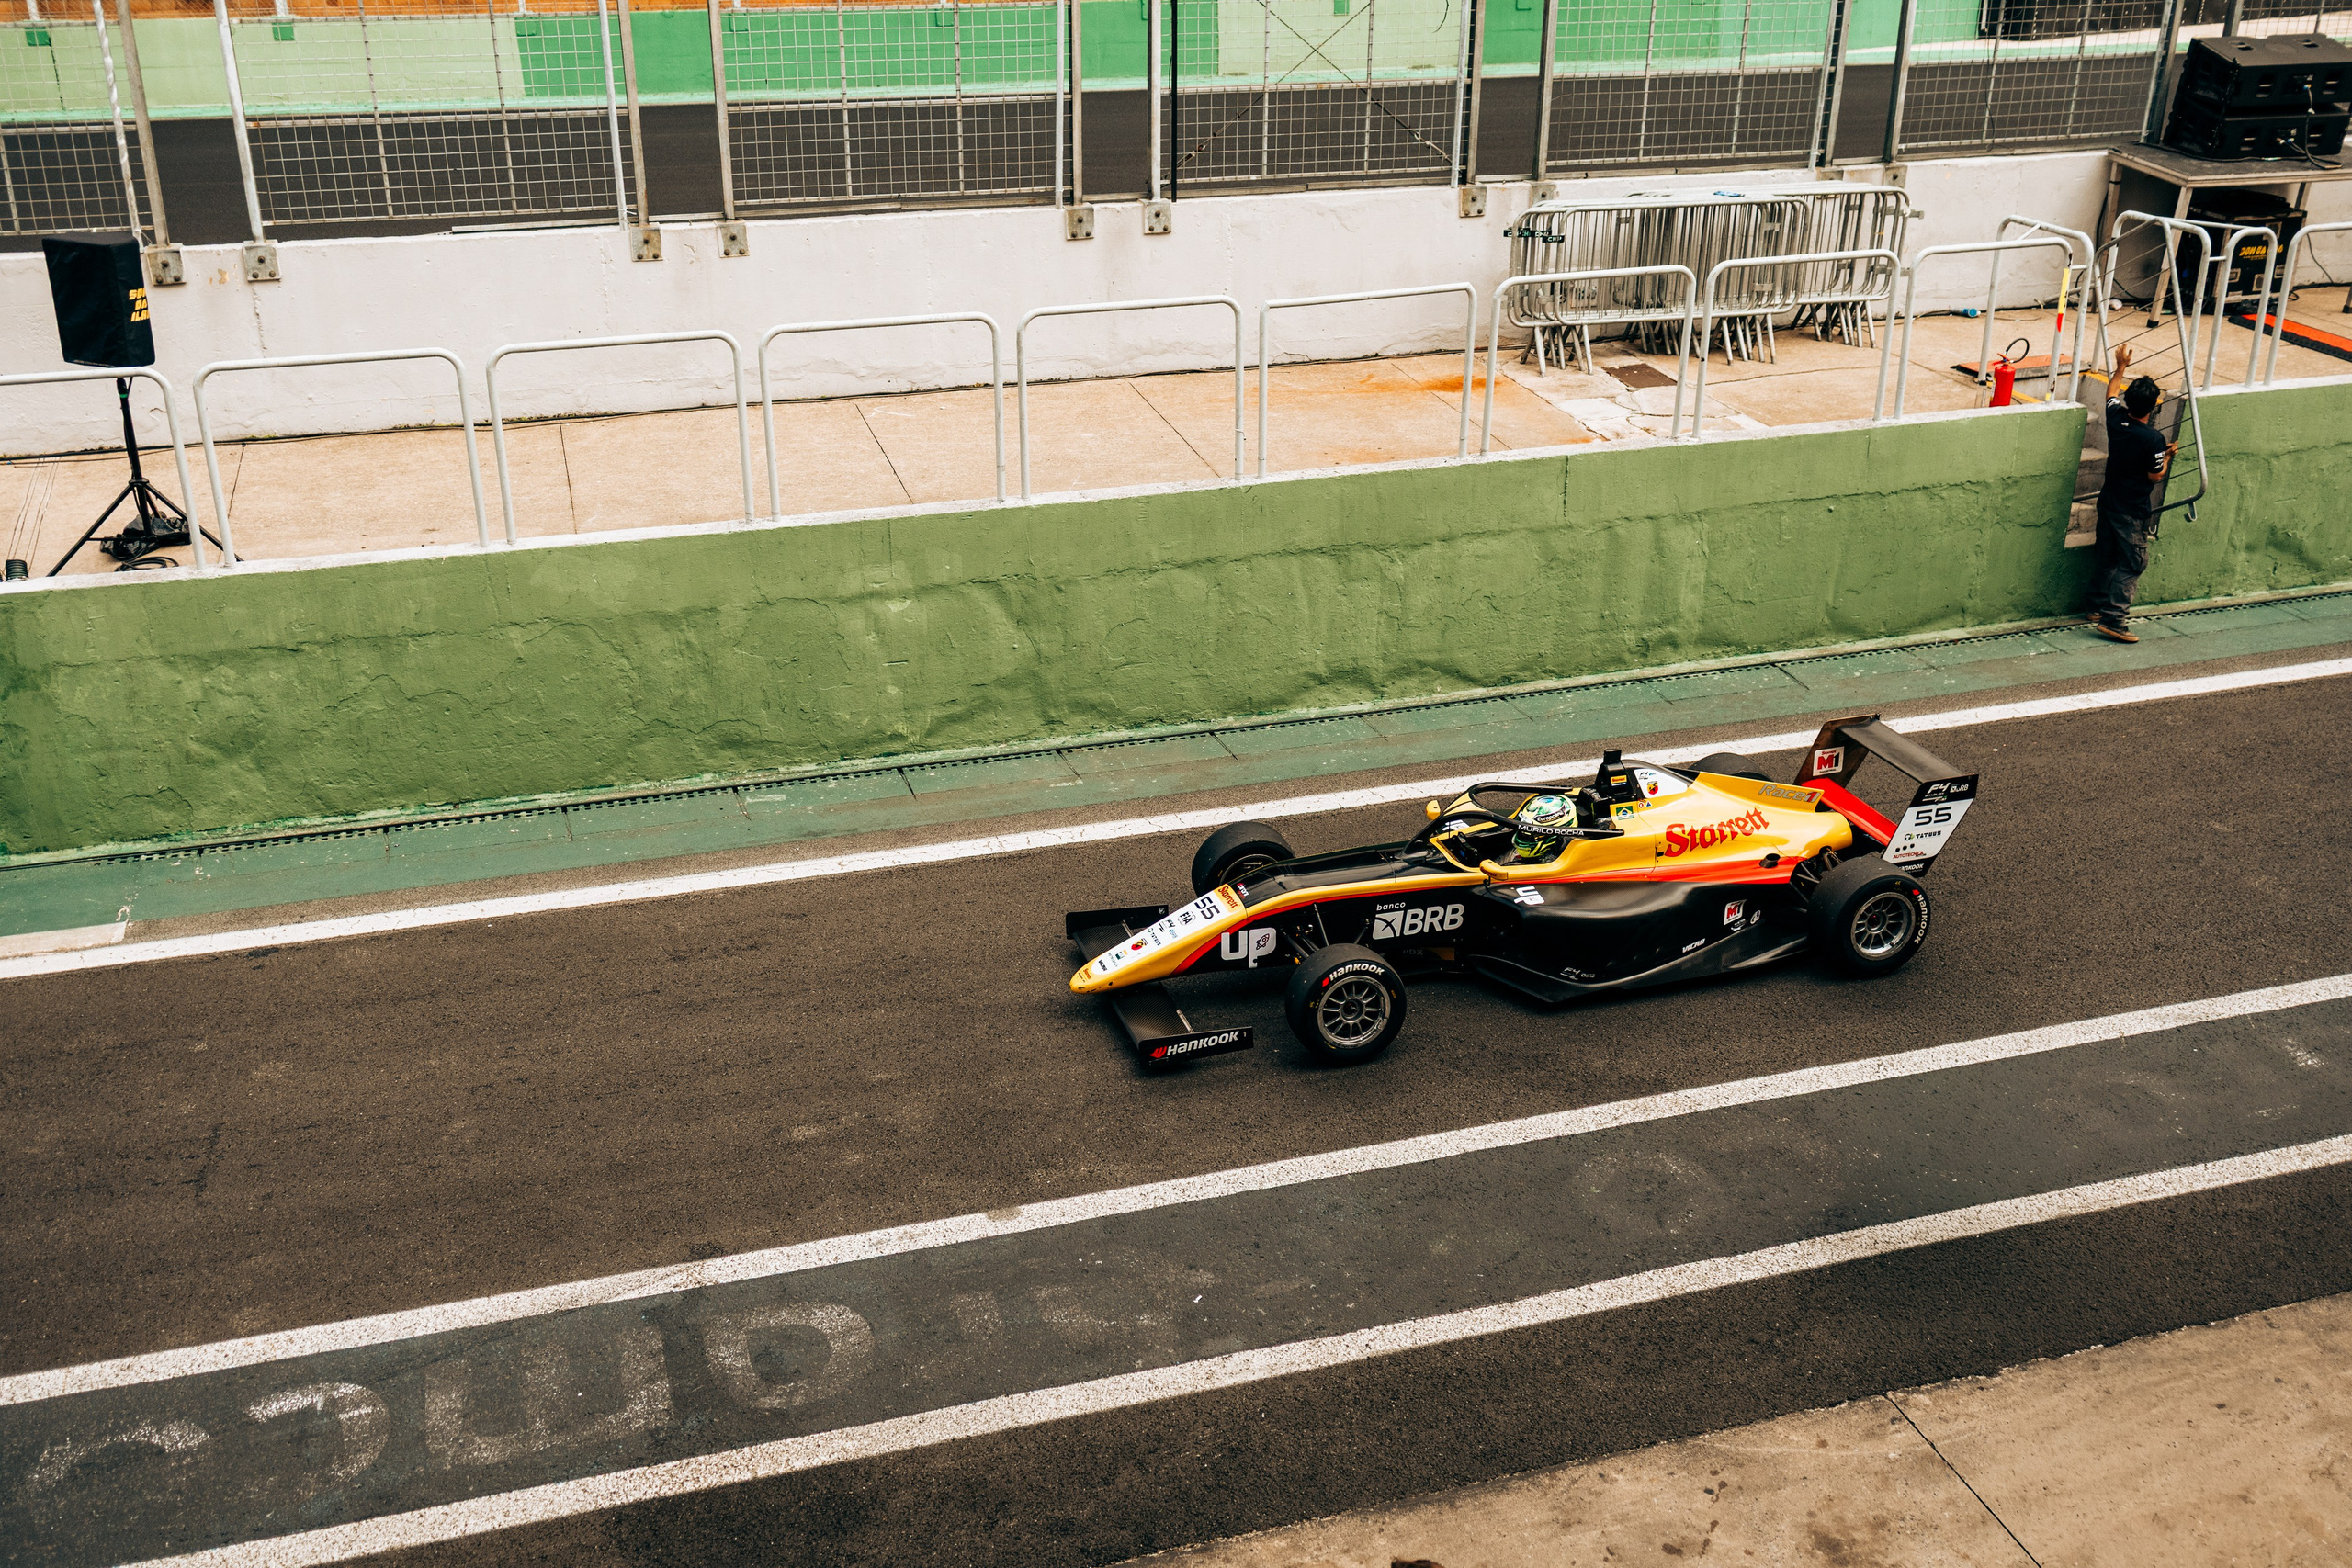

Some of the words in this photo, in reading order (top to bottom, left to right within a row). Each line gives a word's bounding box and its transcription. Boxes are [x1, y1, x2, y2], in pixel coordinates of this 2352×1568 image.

[135, 299, 148, 310] DA
[1758, 784, 1821, 803] Race1
[1927, 782, 1951, 794] F4
[1915, 806, 1952, 826] 55
[1518, 824, 1554, 835] MURILO
[1664, 807, 1770, 857] Starrett
[1194, 896, 1220, 920] 55
[1376, 902, 1406, 911] banco
[1180, 910, 1193, 925] FIA
[1403, 903, 1465, 935] BRB
